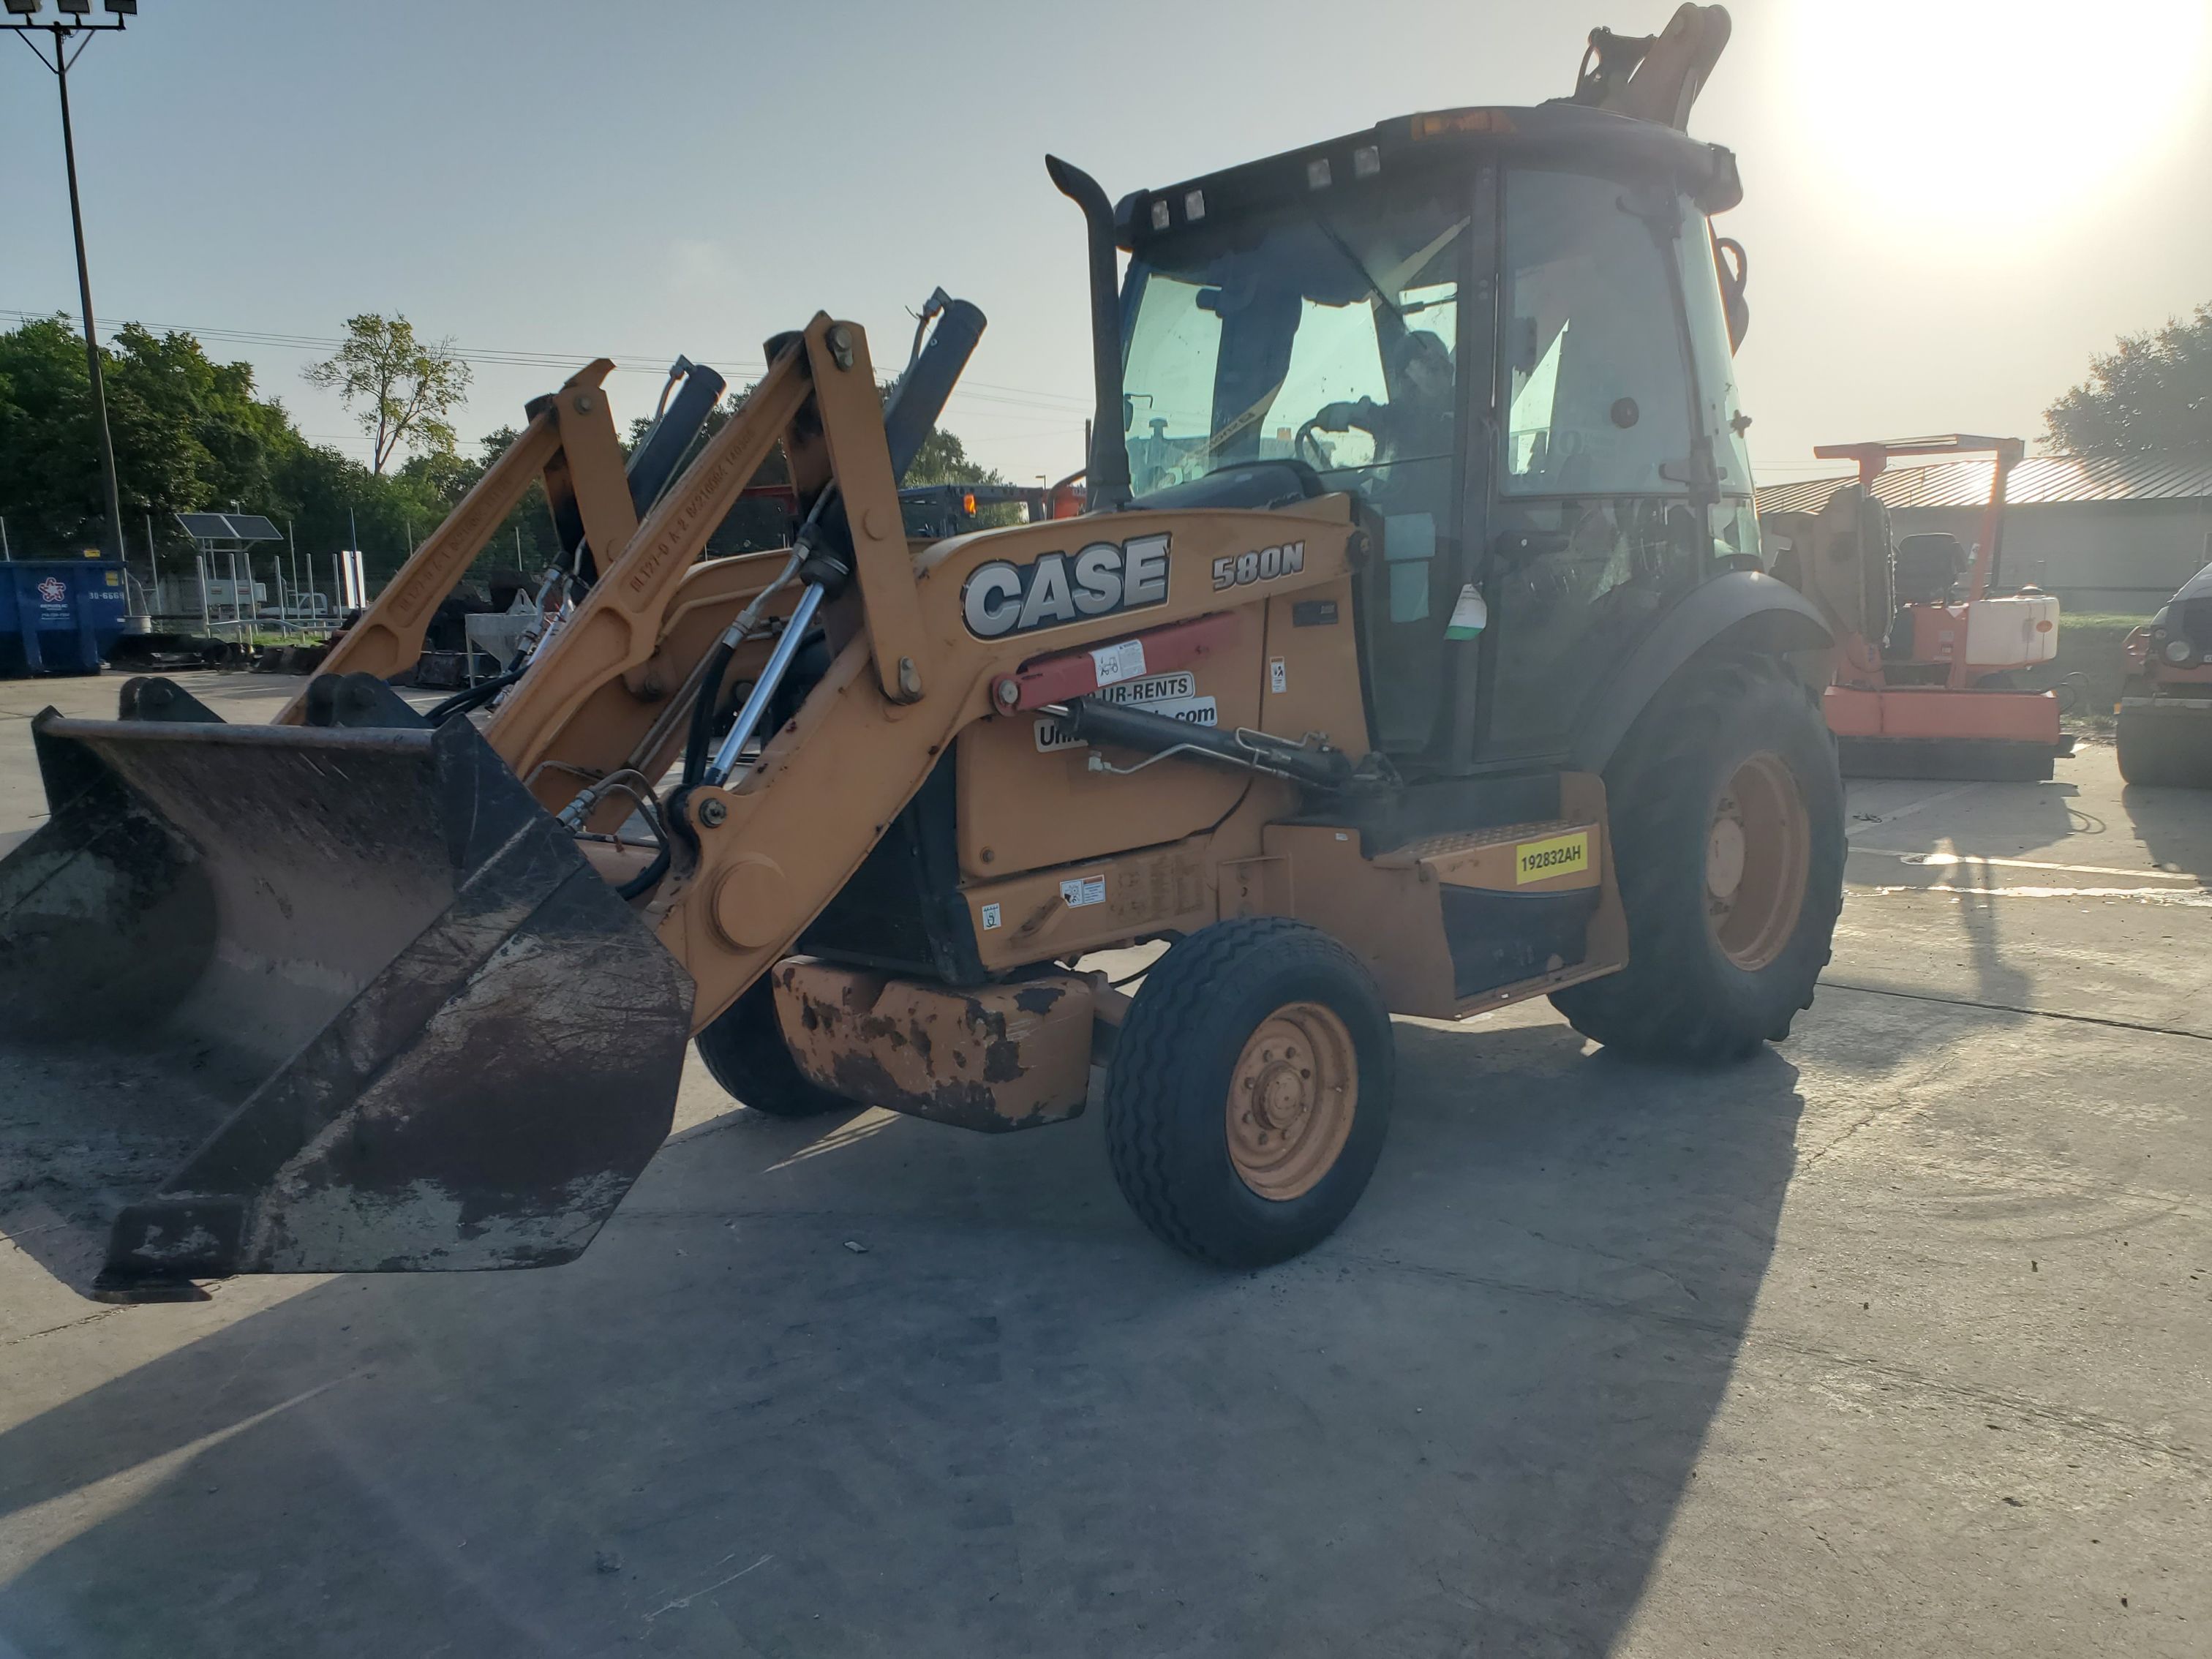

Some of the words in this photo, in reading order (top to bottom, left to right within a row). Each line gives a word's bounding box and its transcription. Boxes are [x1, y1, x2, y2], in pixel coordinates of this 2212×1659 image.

[1213, 541, 1305, 590] 580N
[963, 535, 1170, 636] CASE
[1087, 677, 1188, 704] UR-RENTS
[1521, 844, 1581, 871] 192832AH
